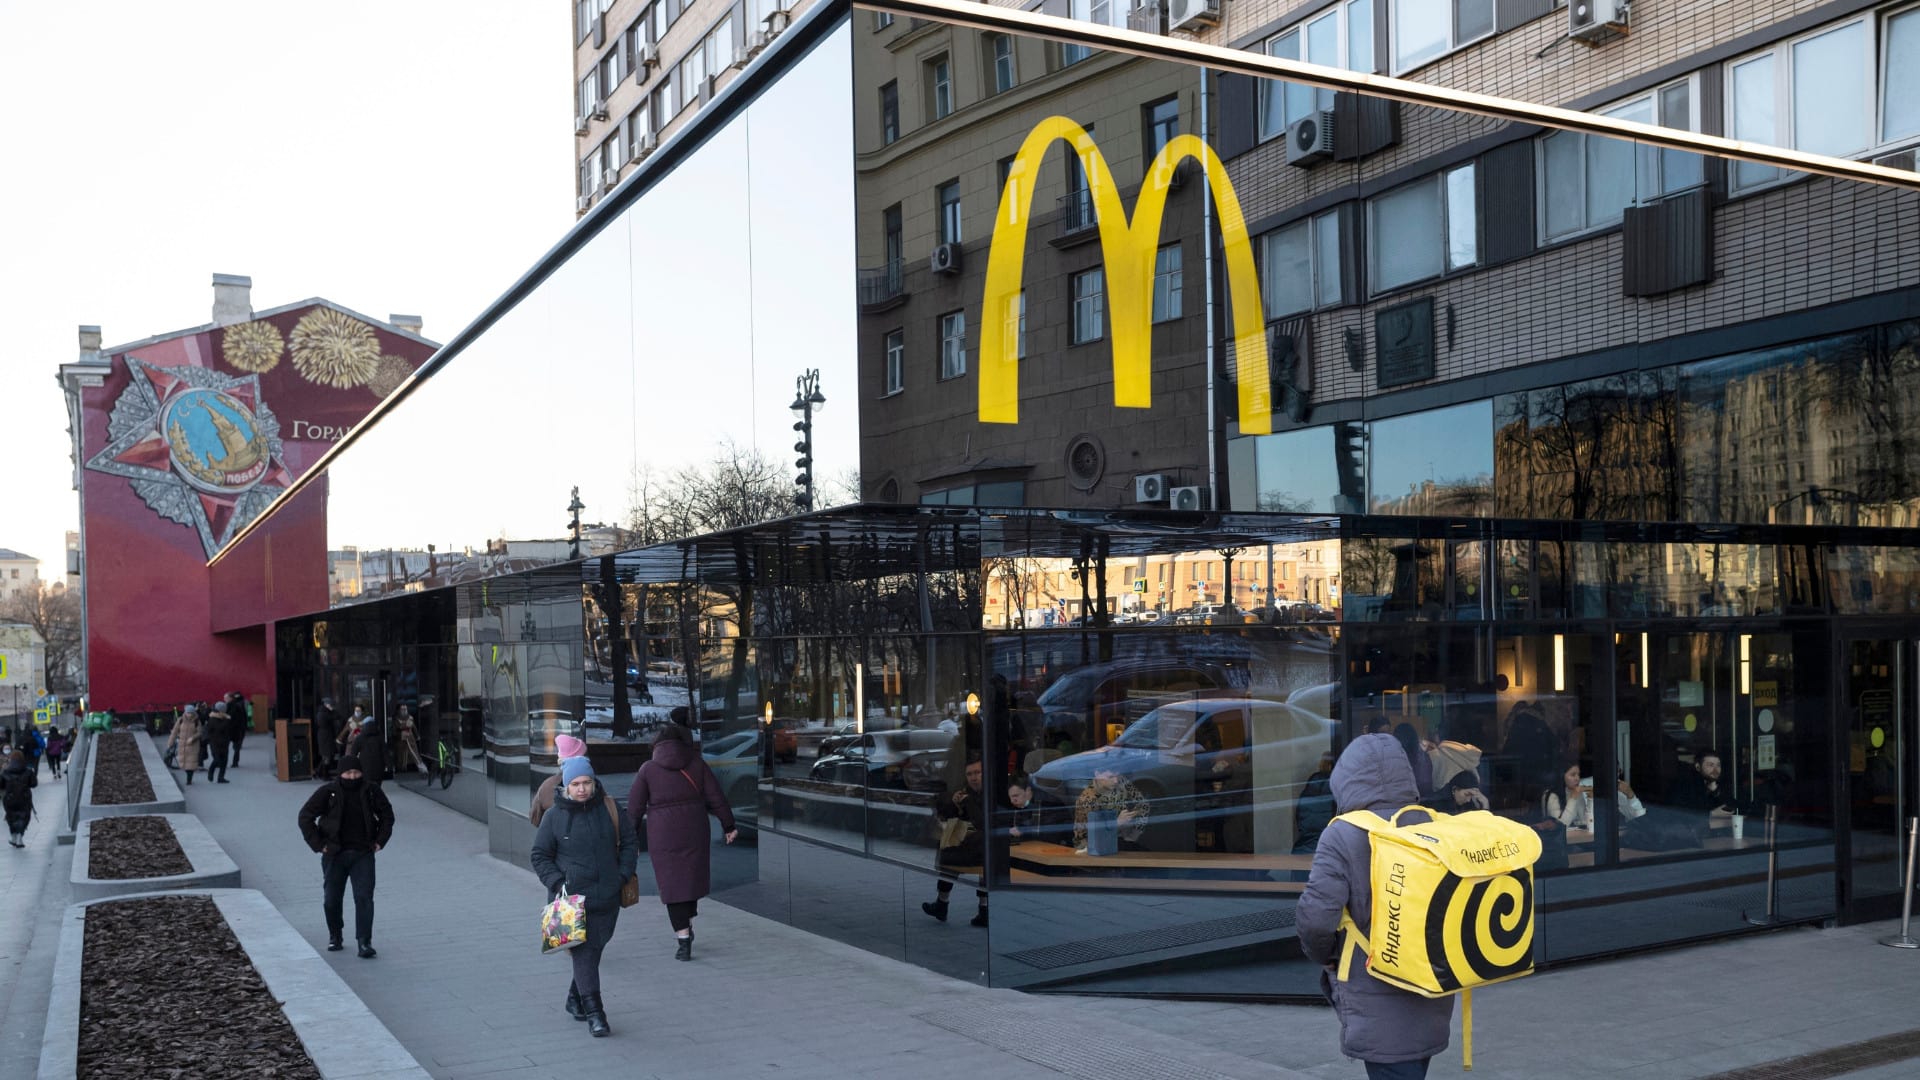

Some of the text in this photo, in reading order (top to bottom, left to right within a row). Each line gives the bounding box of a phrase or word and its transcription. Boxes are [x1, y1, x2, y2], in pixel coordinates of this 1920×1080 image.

[226, 460, 264, 484] ПОБЕДА
[1496, 841, 1521, 859] Еда
[1381, 862, 1405, 968] Яндекс Еда
